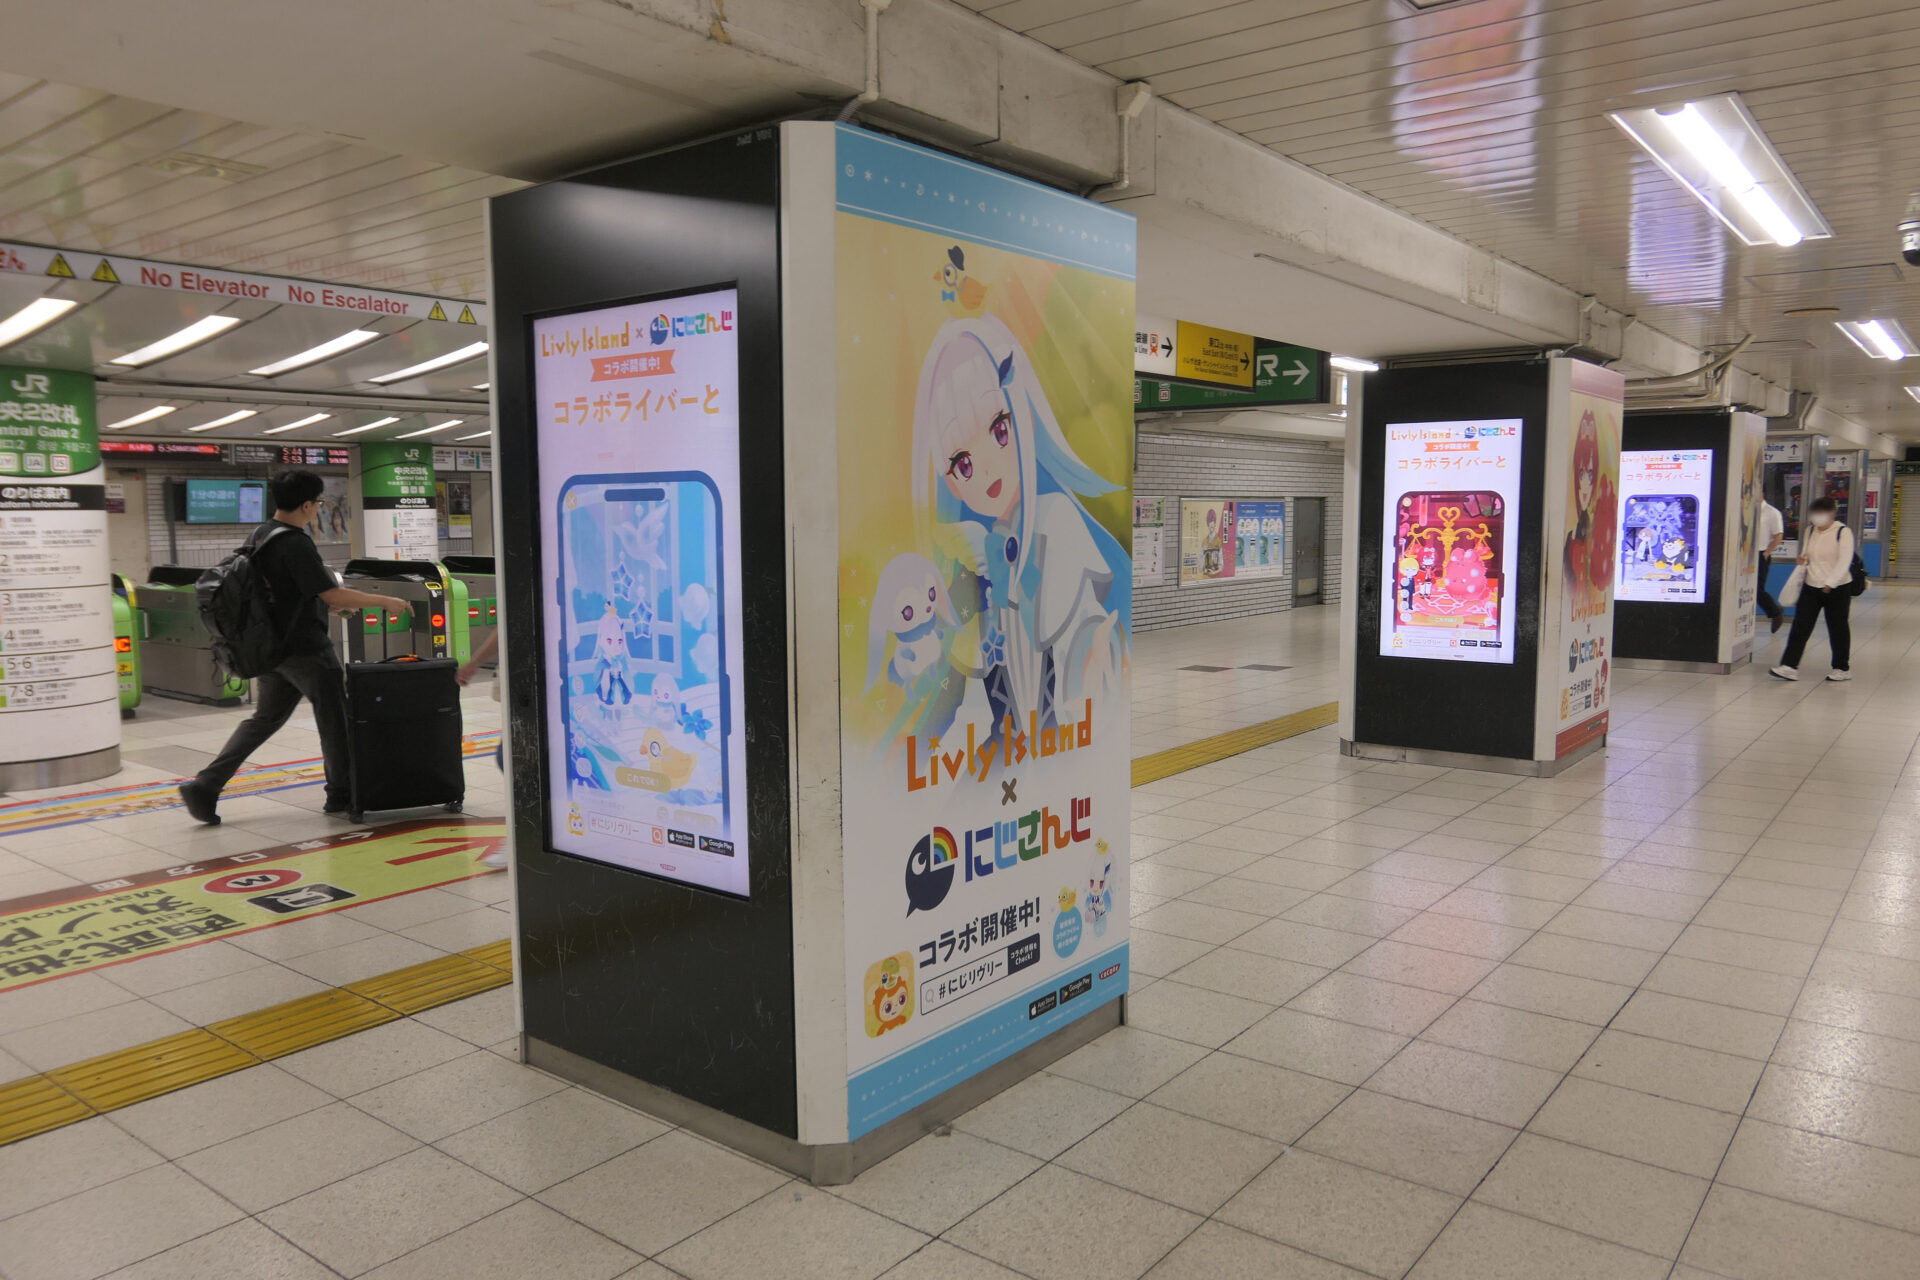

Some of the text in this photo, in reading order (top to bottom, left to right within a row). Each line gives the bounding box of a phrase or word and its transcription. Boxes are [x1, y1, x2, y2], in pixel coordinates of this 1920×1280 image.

[140, 266, 269, 299] No Elevator
[288, 285, 408, 315] No Escalator
[672, 310, 732, 338] にじさんじ
[541, 332, 579, 358] Livly
[582, 322, 630, 352] Island
[11, 374, 50, 394] JR
[554, 384, 719, 426] コラボライバーと
[38, 426, 69, 438] Gate
[70, 428, 79, 439] 2
[1391, 428, 1451, 441] Livly Island
[405, 449, 419, 458] JR
[1398, 456, 1507, 470] コラボライバーと
[1626, 472, 1702, 480] コラボライバーと
[1, 487, 70, 500] のりば案内
[2, 593, 13, 606] 3
[4, 630, 15, 641] 4
[906, 698, 1092, 792] Livly Island
[965, 797, 1091, 882] にじさんじ
[919, 897, 1040, 969] コラボ開催中!
[0, 913, 247, 981] 西武池
[1068, 982, 1082, 992] Google
